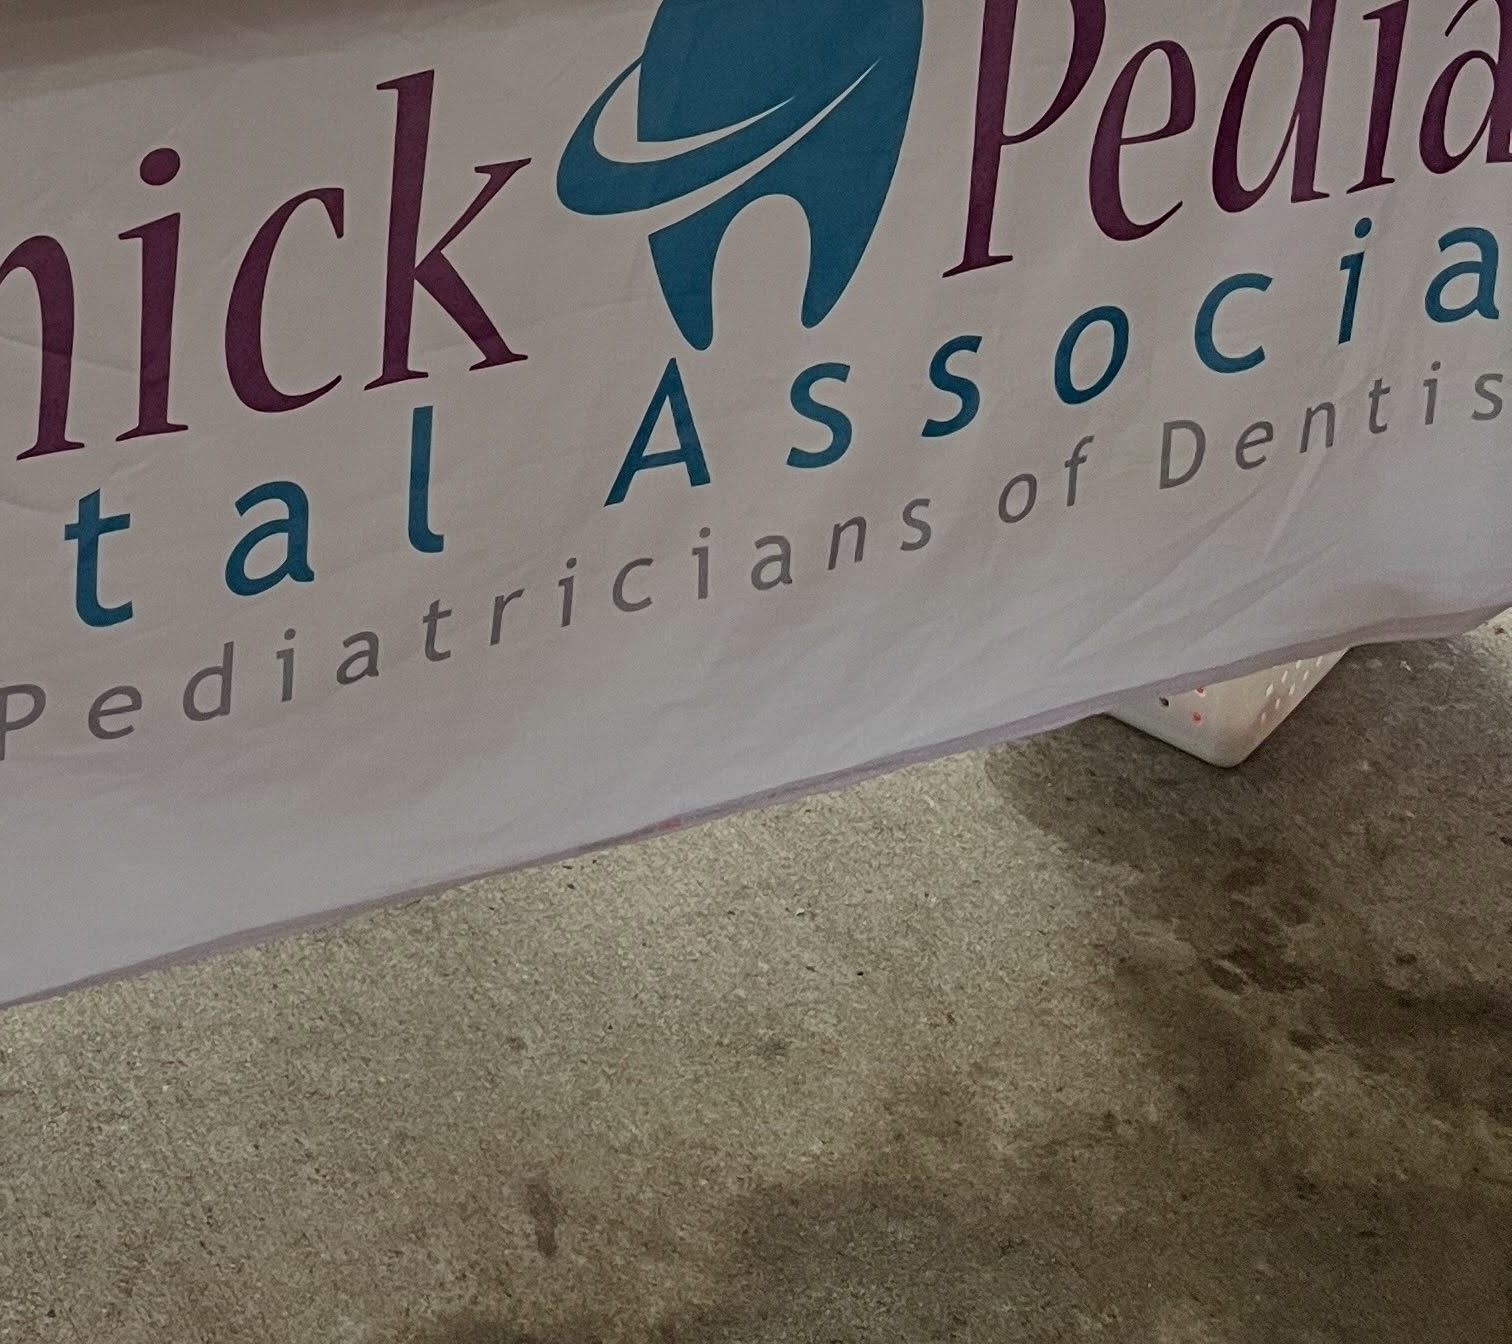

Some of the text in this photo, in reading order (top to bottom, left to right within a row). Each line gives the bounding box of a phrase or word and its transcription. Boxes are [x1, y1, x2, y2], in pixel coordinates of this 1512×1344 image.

[604, 216, 1500, 507] Associa
[997, 434, 1095, 523] of
[1158, 361, 1504, 490] Dentis
